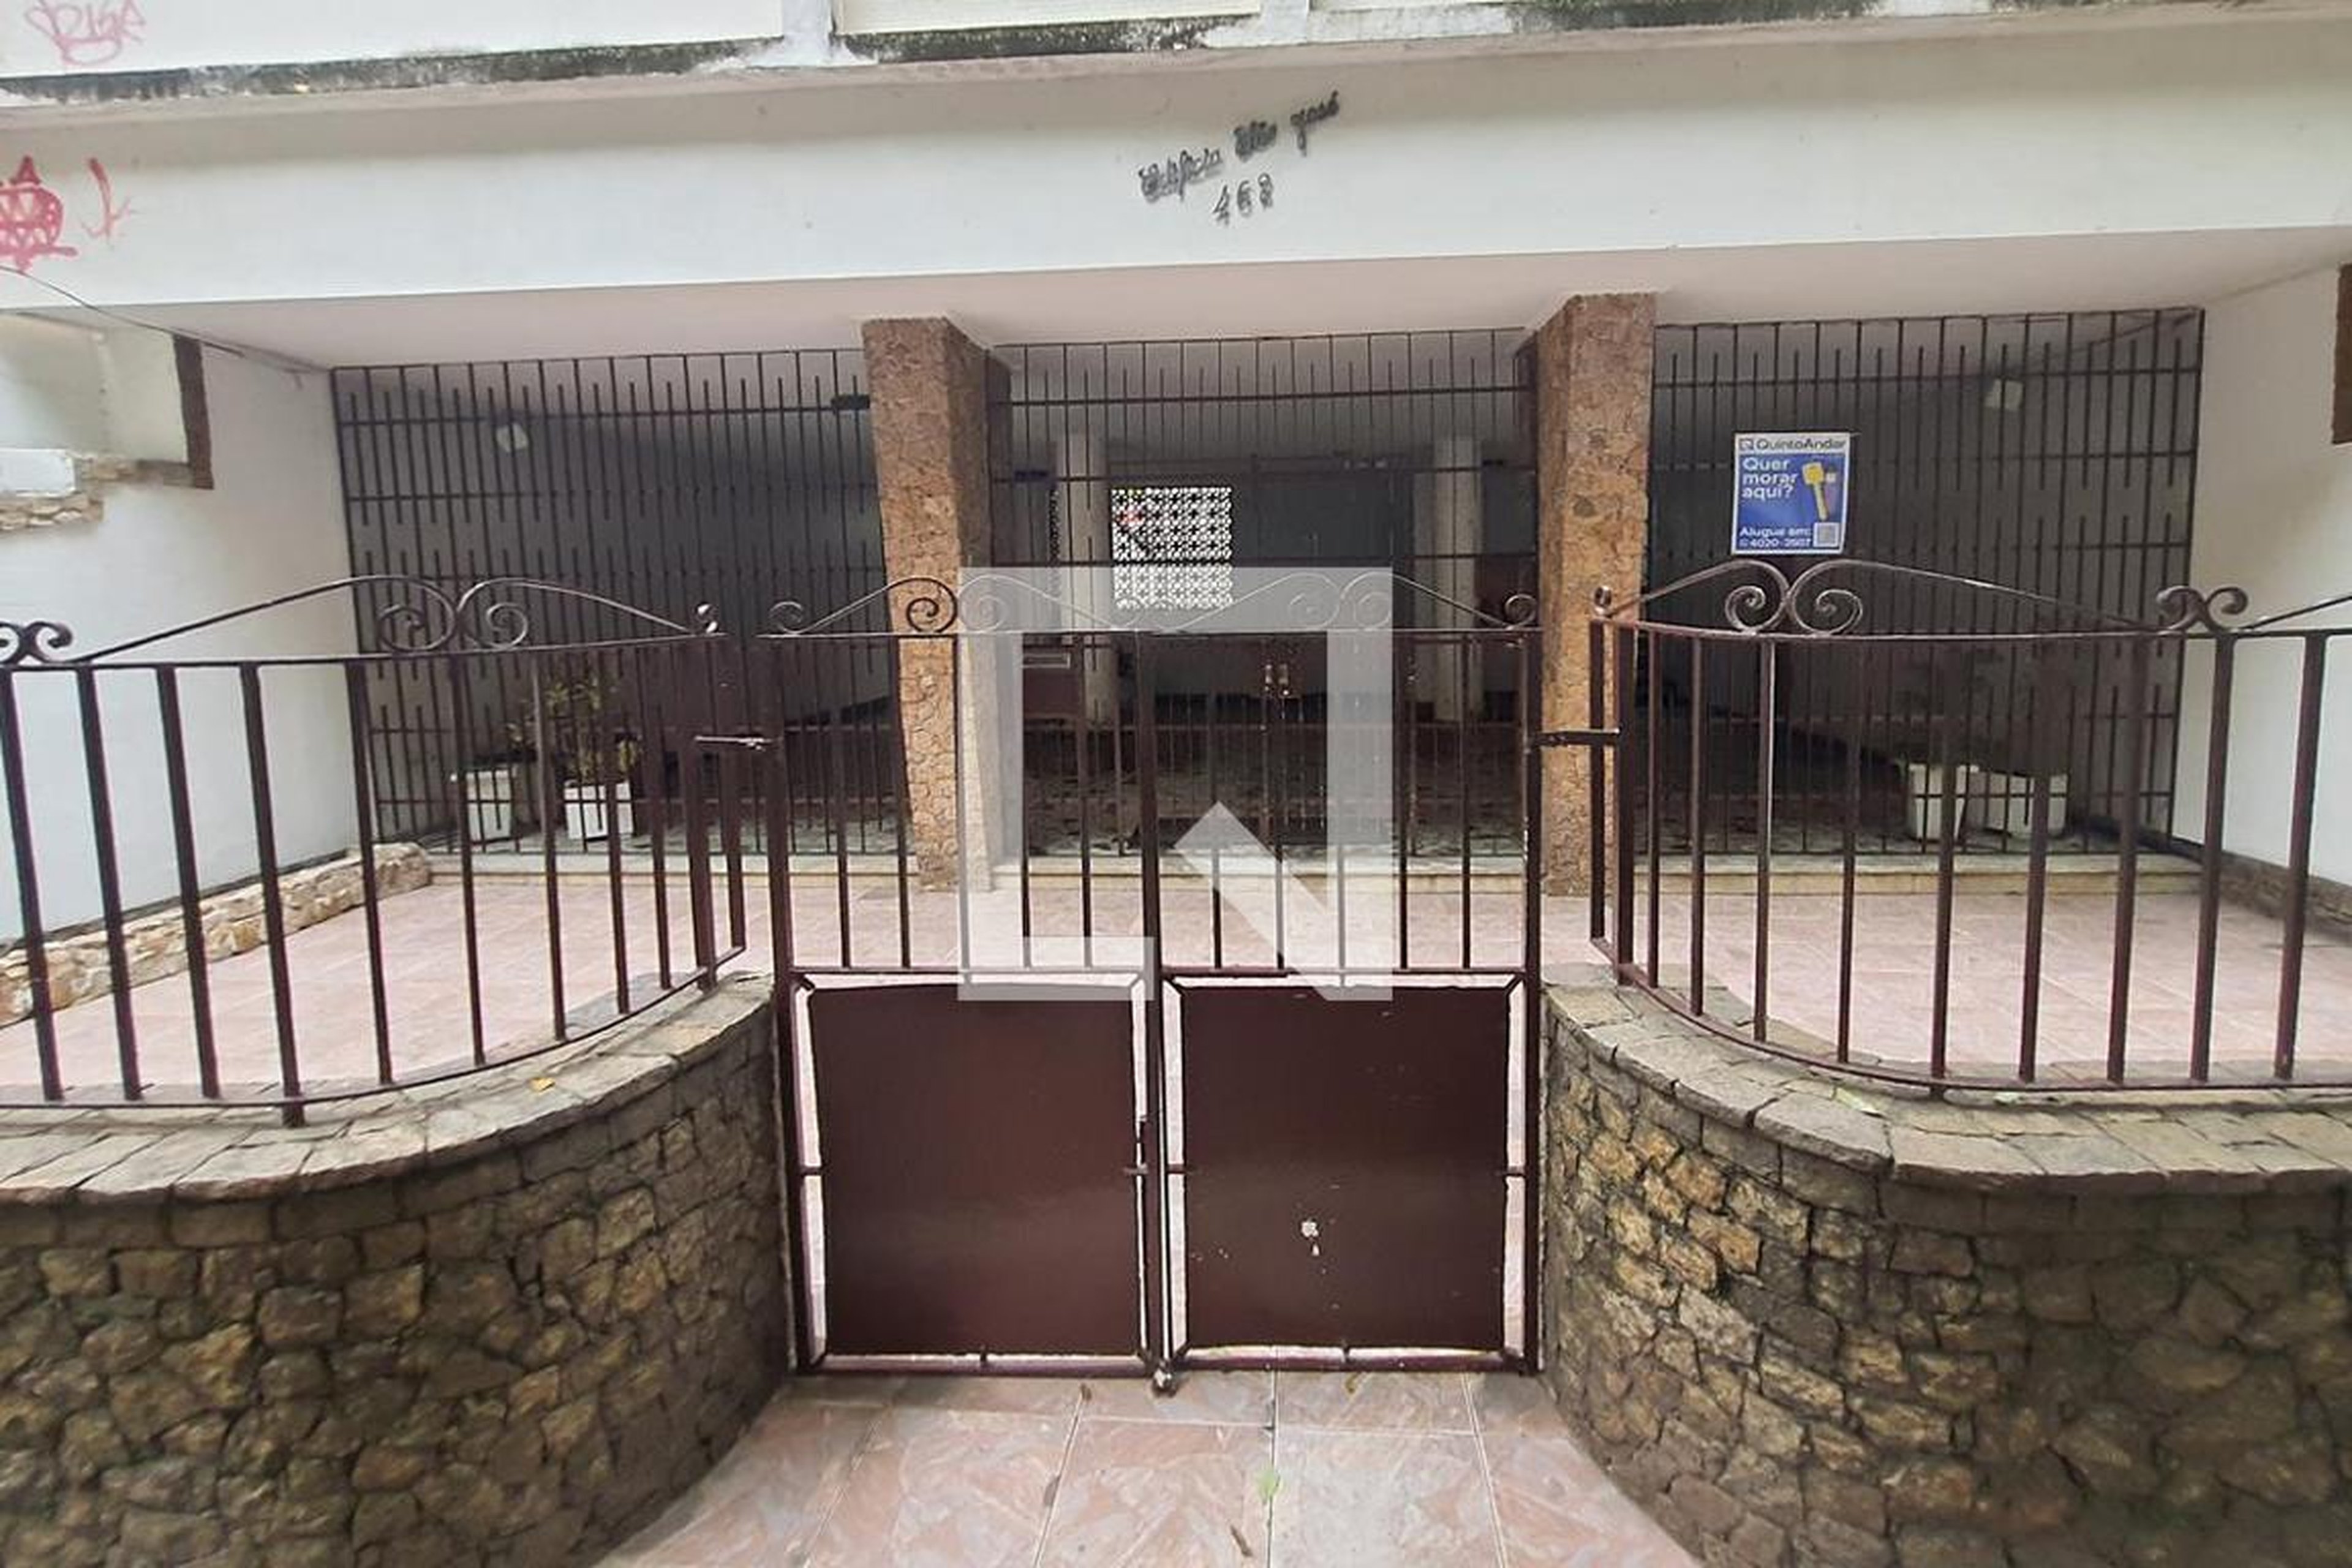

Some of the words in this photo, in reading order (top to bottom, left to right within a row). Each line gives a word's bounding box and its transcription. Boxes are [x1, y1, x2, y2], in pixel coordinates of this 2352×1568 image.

[1756, 437, 1845, 450] QuintoAndar
[1742, 457, 1790, 472] Quer
[1743, 473, 1798, 486] morar
[1741, 486, 1794, 500] aqui?
[1739, 526, 1785, 538] Alugue
